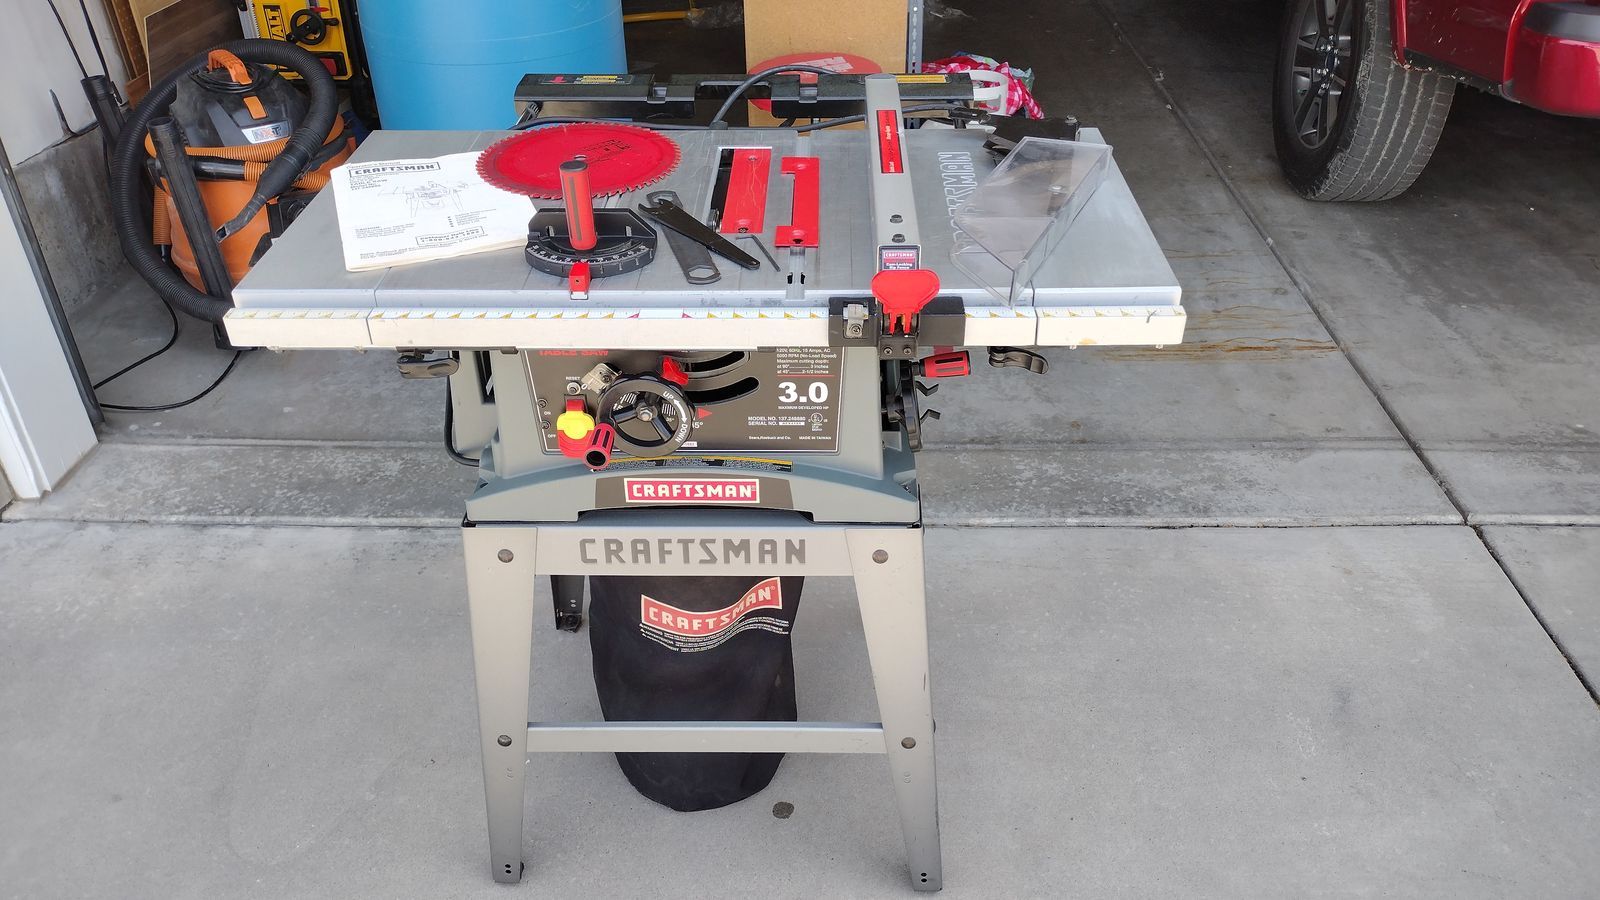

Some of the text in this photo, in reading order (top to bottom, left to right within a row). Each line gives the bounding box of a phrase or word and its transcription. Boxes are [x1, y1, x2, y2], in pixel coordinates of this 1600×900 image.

[354, 164, 435, 175] CRAFTSMAN
[663, 391, 675, 400] UP
[778, 381, 828, 403] 3.0
[675, 423, 689, 443] DOWN
[632, 484, 752, 498] CRAFTSMAN
[579, 538, 806, 564] CRAFTSMAN
[649, 586, 772, 631] CRAFTSMAN
